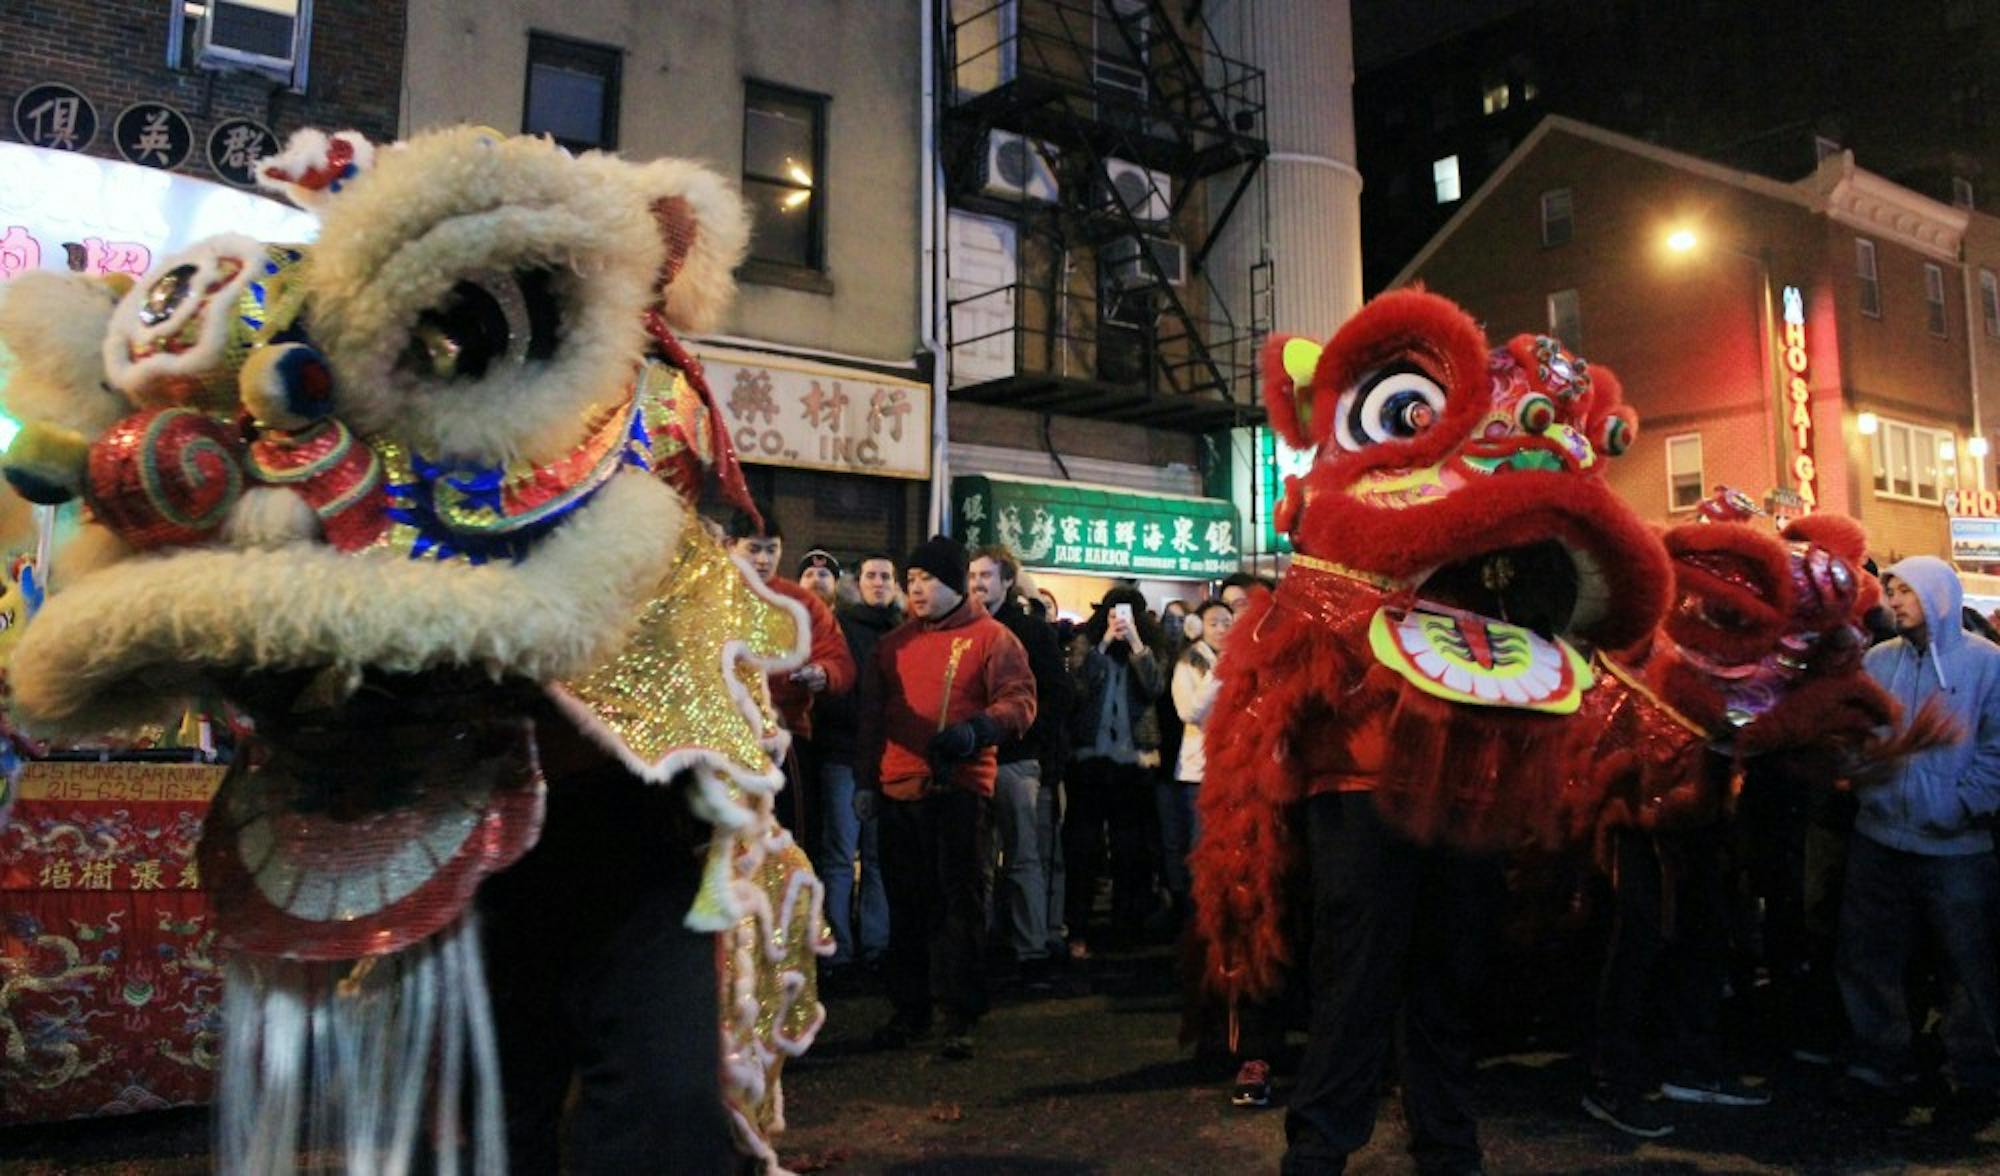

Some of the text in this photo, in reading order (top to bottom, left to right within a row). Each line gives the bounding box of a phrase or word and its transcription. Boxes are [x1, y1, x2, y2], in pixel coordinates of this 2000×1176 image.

[1790, 376, 1811, 450] SAI
[1054, 545, 1083, 565] JADE
[1085, 547, 1130, 567] HARBOR
